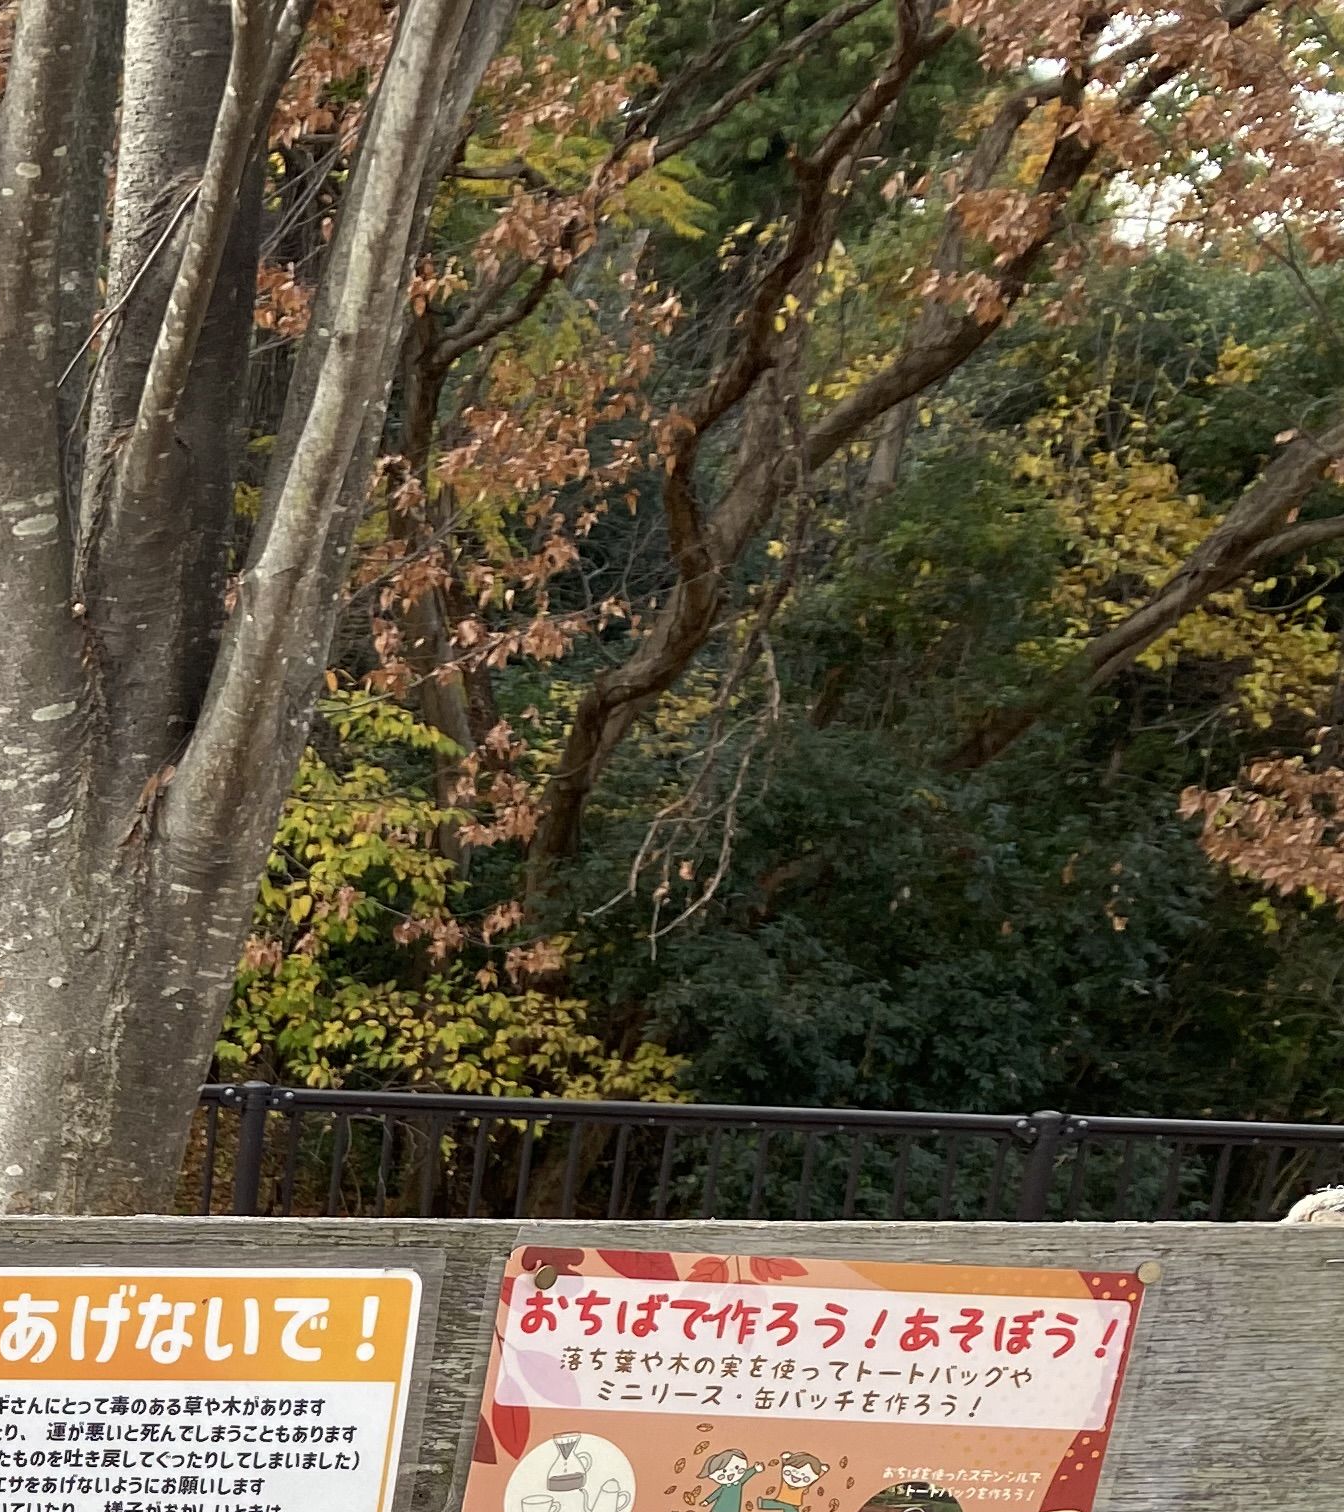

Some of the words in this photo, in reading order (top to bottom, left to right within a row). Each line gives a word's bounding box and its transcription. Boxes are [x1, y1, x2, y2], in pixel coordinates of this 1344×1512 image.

[519, 1291, 1118, 1361] おちばで作ろう！あそぼう！
[560, 1346, 1033, 1384] 落ち葉や木の実を使ってトートバッグや
